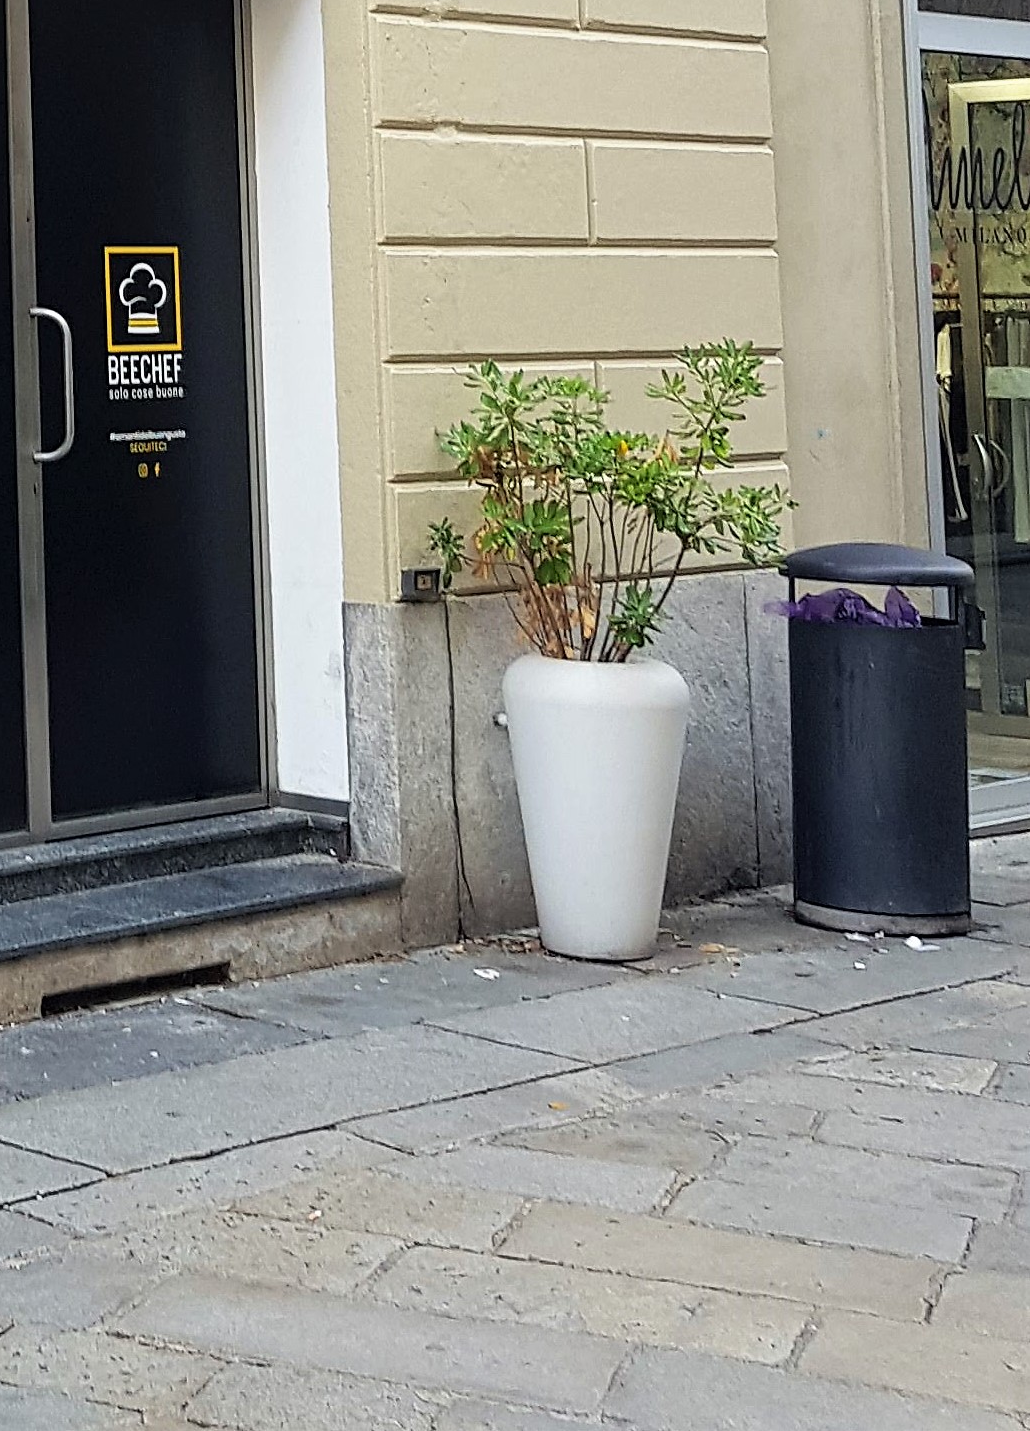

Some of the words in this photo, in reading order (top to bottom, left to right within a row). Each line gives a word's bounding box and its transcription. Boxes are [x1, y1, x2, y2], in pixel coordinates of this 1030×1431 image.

[107, 353, 183, 386] BEECHEF
[108, 386, 130, 401] solo
[131, 387, 154, 400] cose
[155, 385, 184, 399] buone
